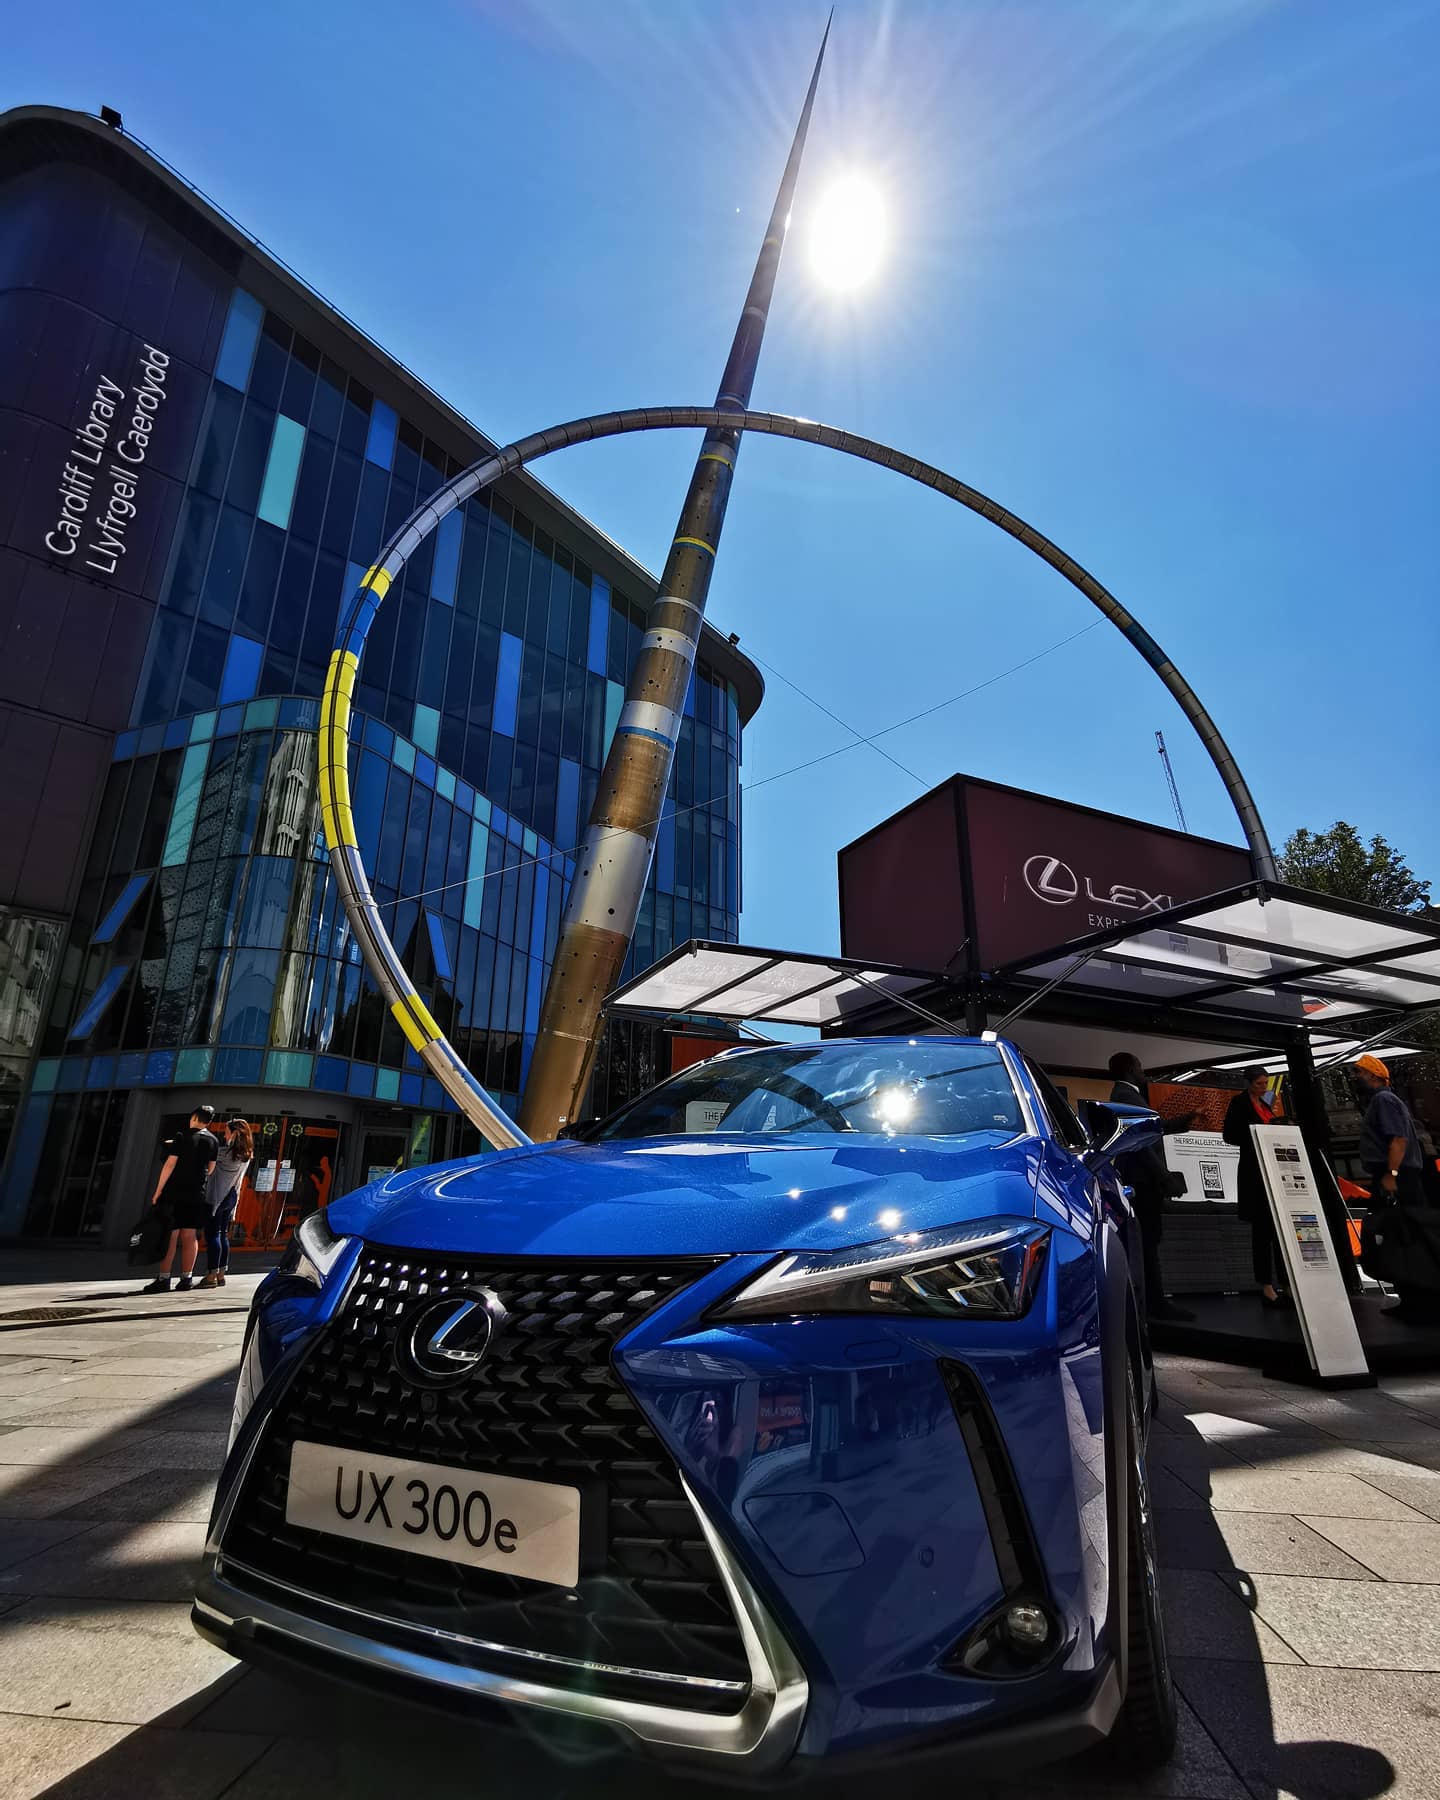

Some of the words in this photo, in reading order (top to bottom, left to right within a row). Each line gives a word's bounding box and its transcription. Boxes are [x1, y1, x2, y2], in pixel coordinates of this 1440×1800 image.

[45, 462, 95, 556] Cardiff
[71, 374, 125, 466] Library
[86, 464, 139, 574] Llyfrgell
[117, 344, 171, 464] Caerdydd
[1084, 876, 1172, 912] LEX
[1088, 913, 1127, 928] EXPE
[335, 1466, 394, 1528] UX
[402, 1479, 518, 1553] 300e
